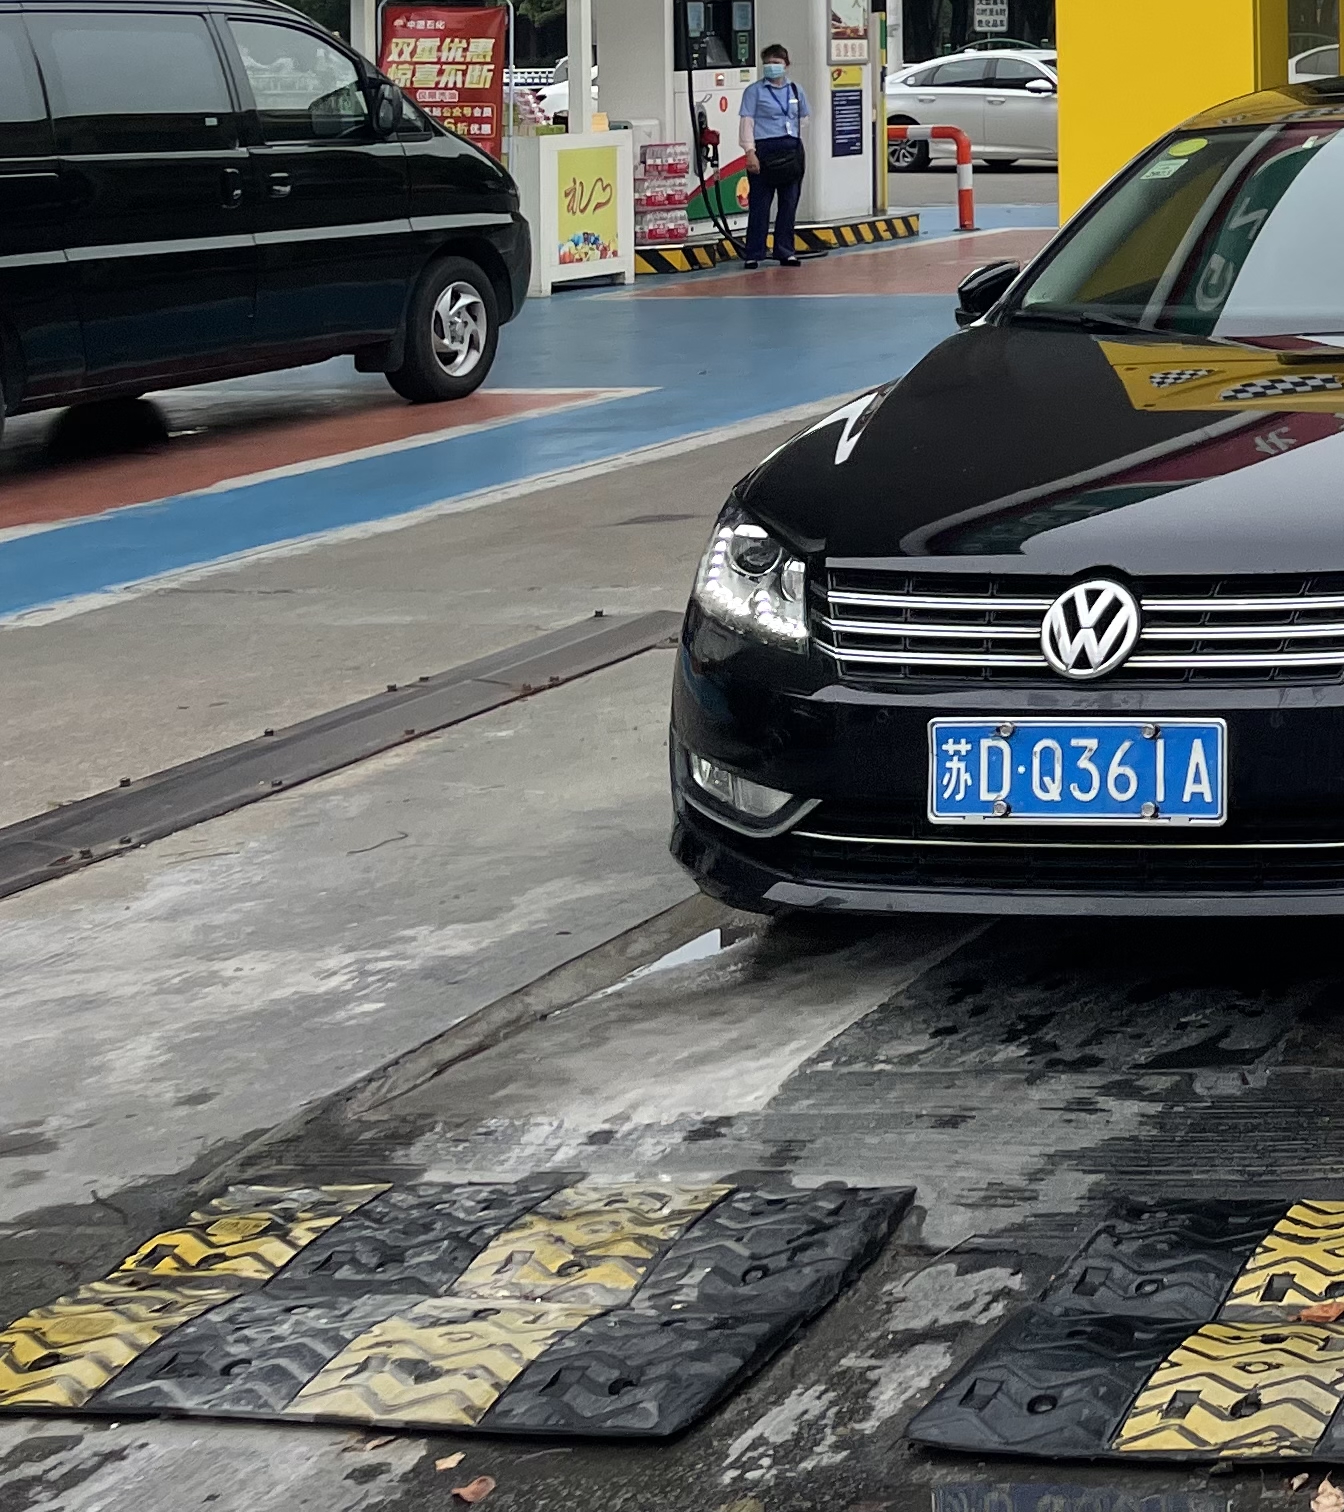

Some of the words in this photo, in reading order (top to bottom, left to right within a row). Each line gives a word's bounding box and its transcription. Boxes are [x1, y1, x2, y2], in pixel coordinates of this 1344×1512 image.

[387, 37, 496, 62] 双重优惠
[387, 64, 496, 88] 惊喜不断
